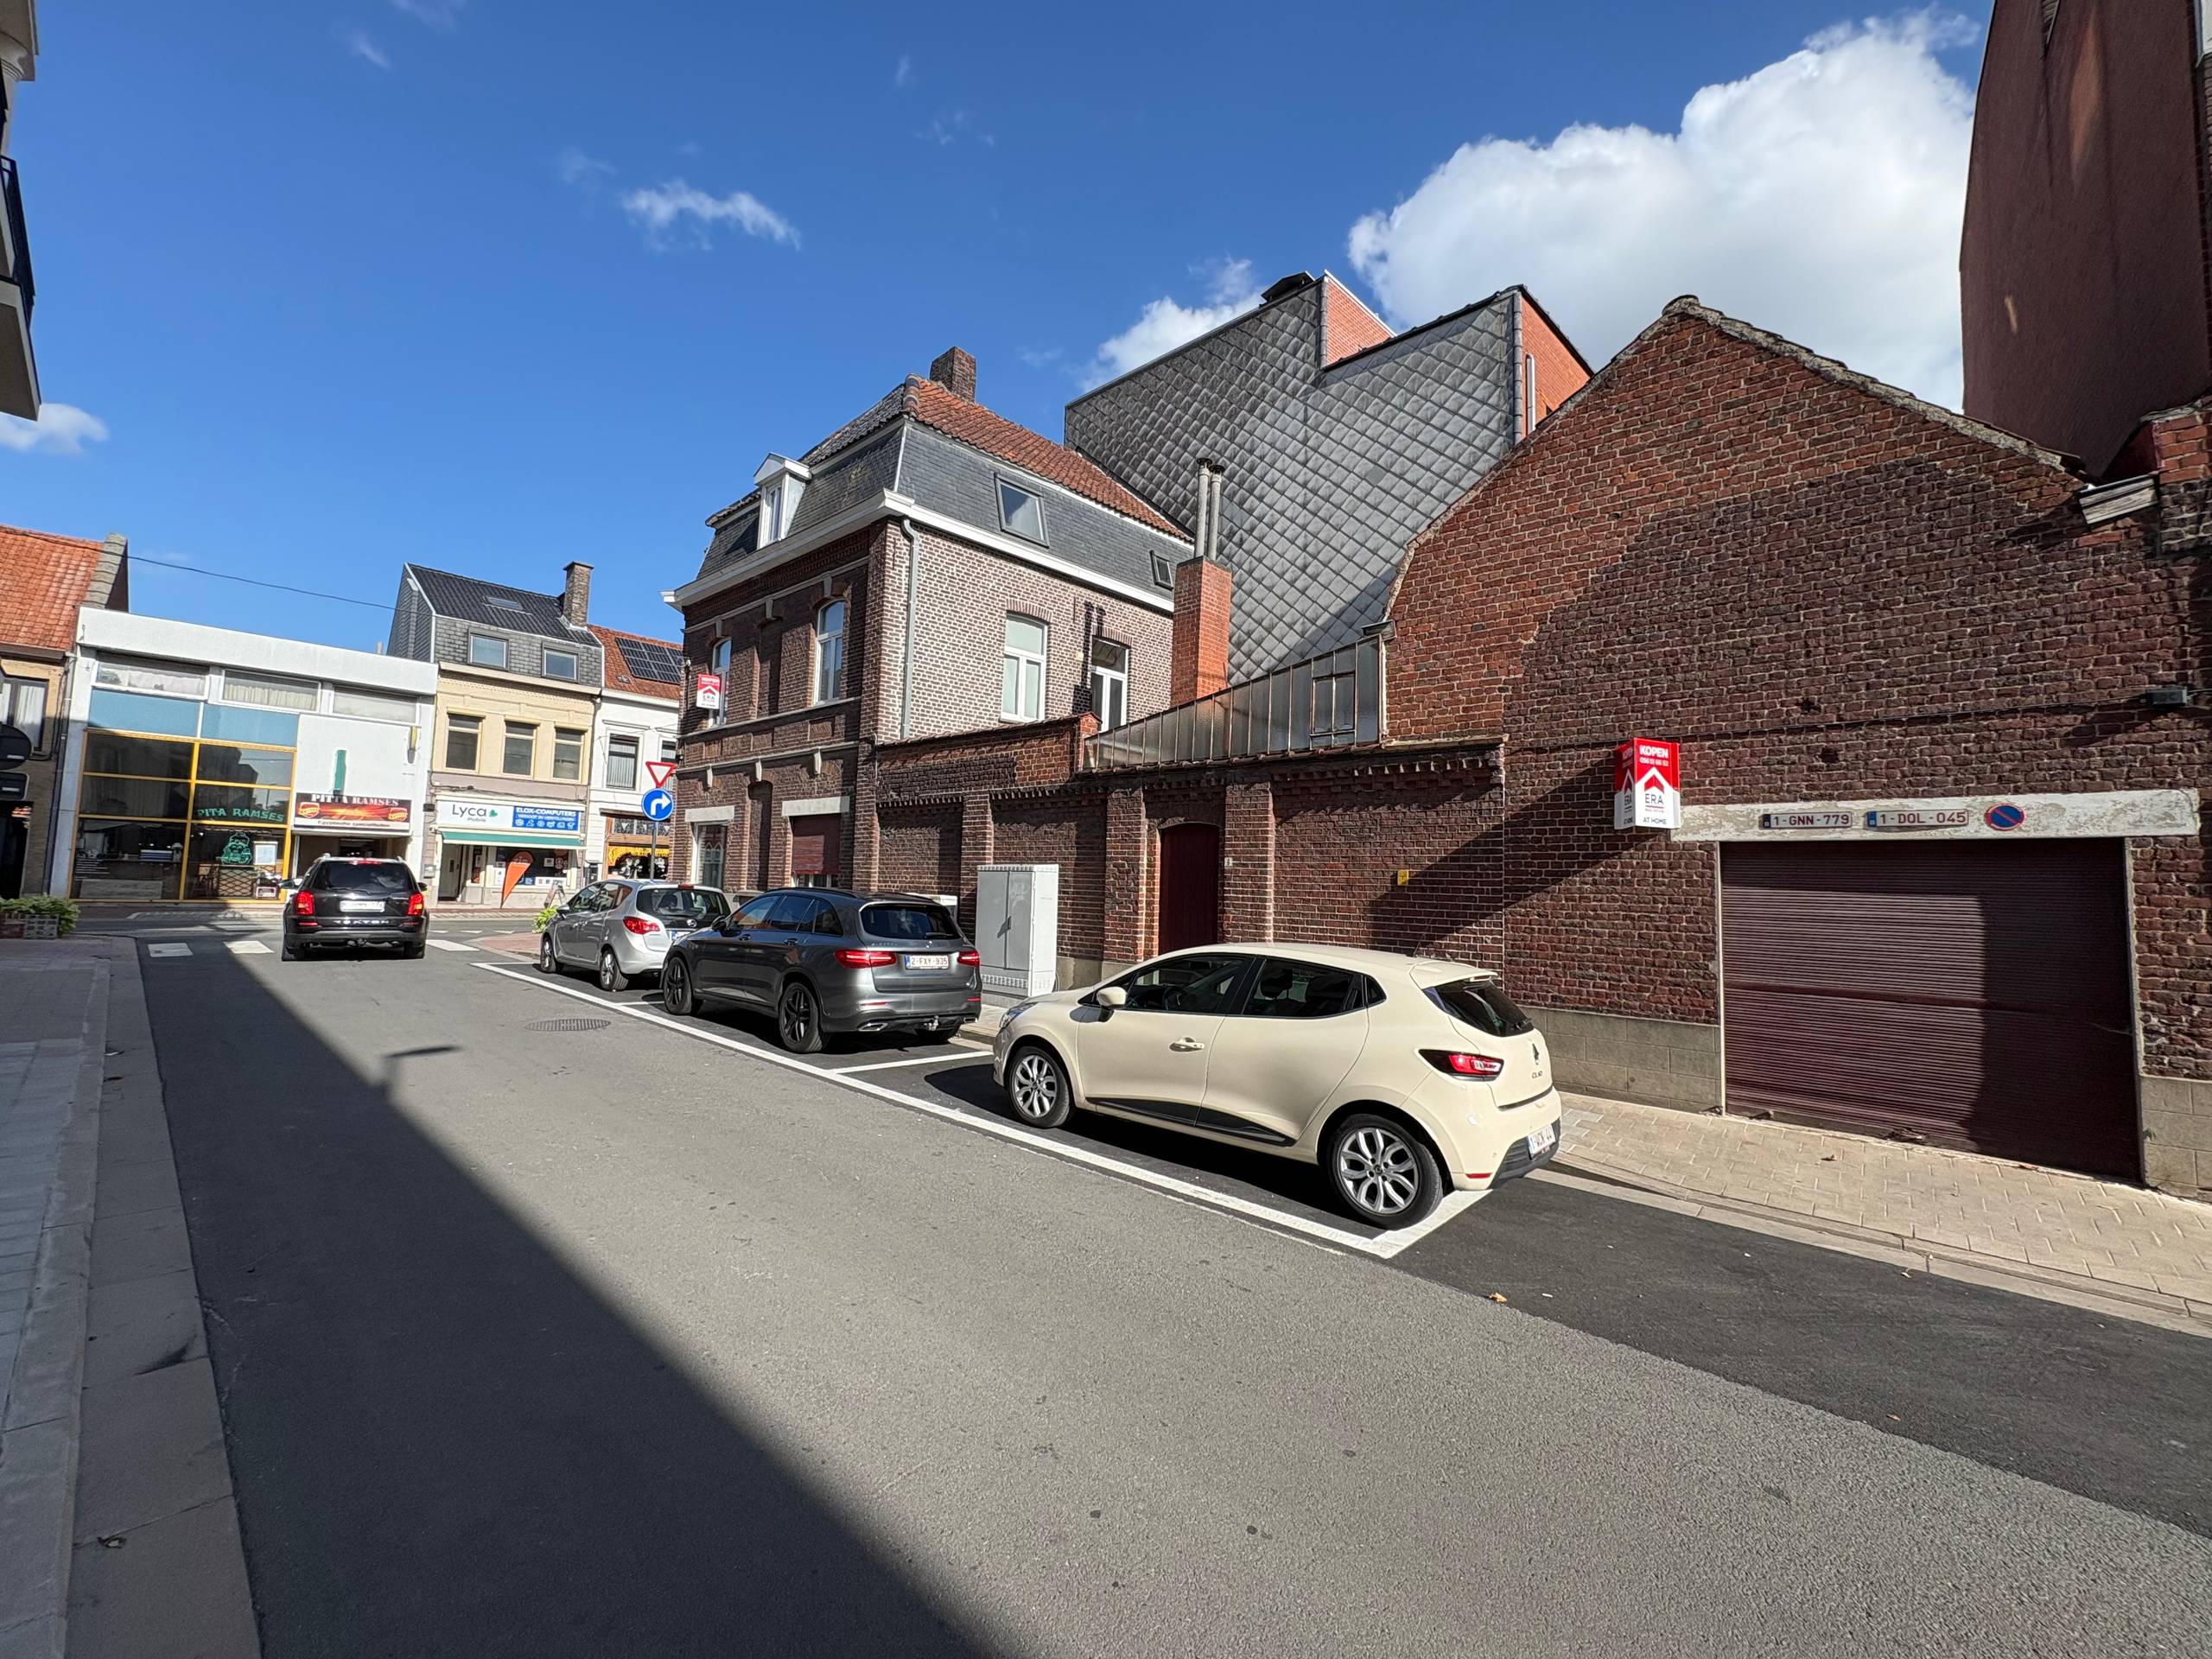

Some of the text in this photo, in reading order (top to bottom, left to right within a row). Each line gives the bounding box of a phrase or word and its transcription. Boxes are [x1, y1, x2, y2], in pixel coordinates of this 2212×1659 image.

[1639, 745, 1669, 759] KOPEN
[311, 793, 399, 807] PITTA RAMSES
[1644, 793, 1664, 805] ERA
[196, 808, 284, 822] PITA RAMSES
[452, 804, 487, 817] Lyca
